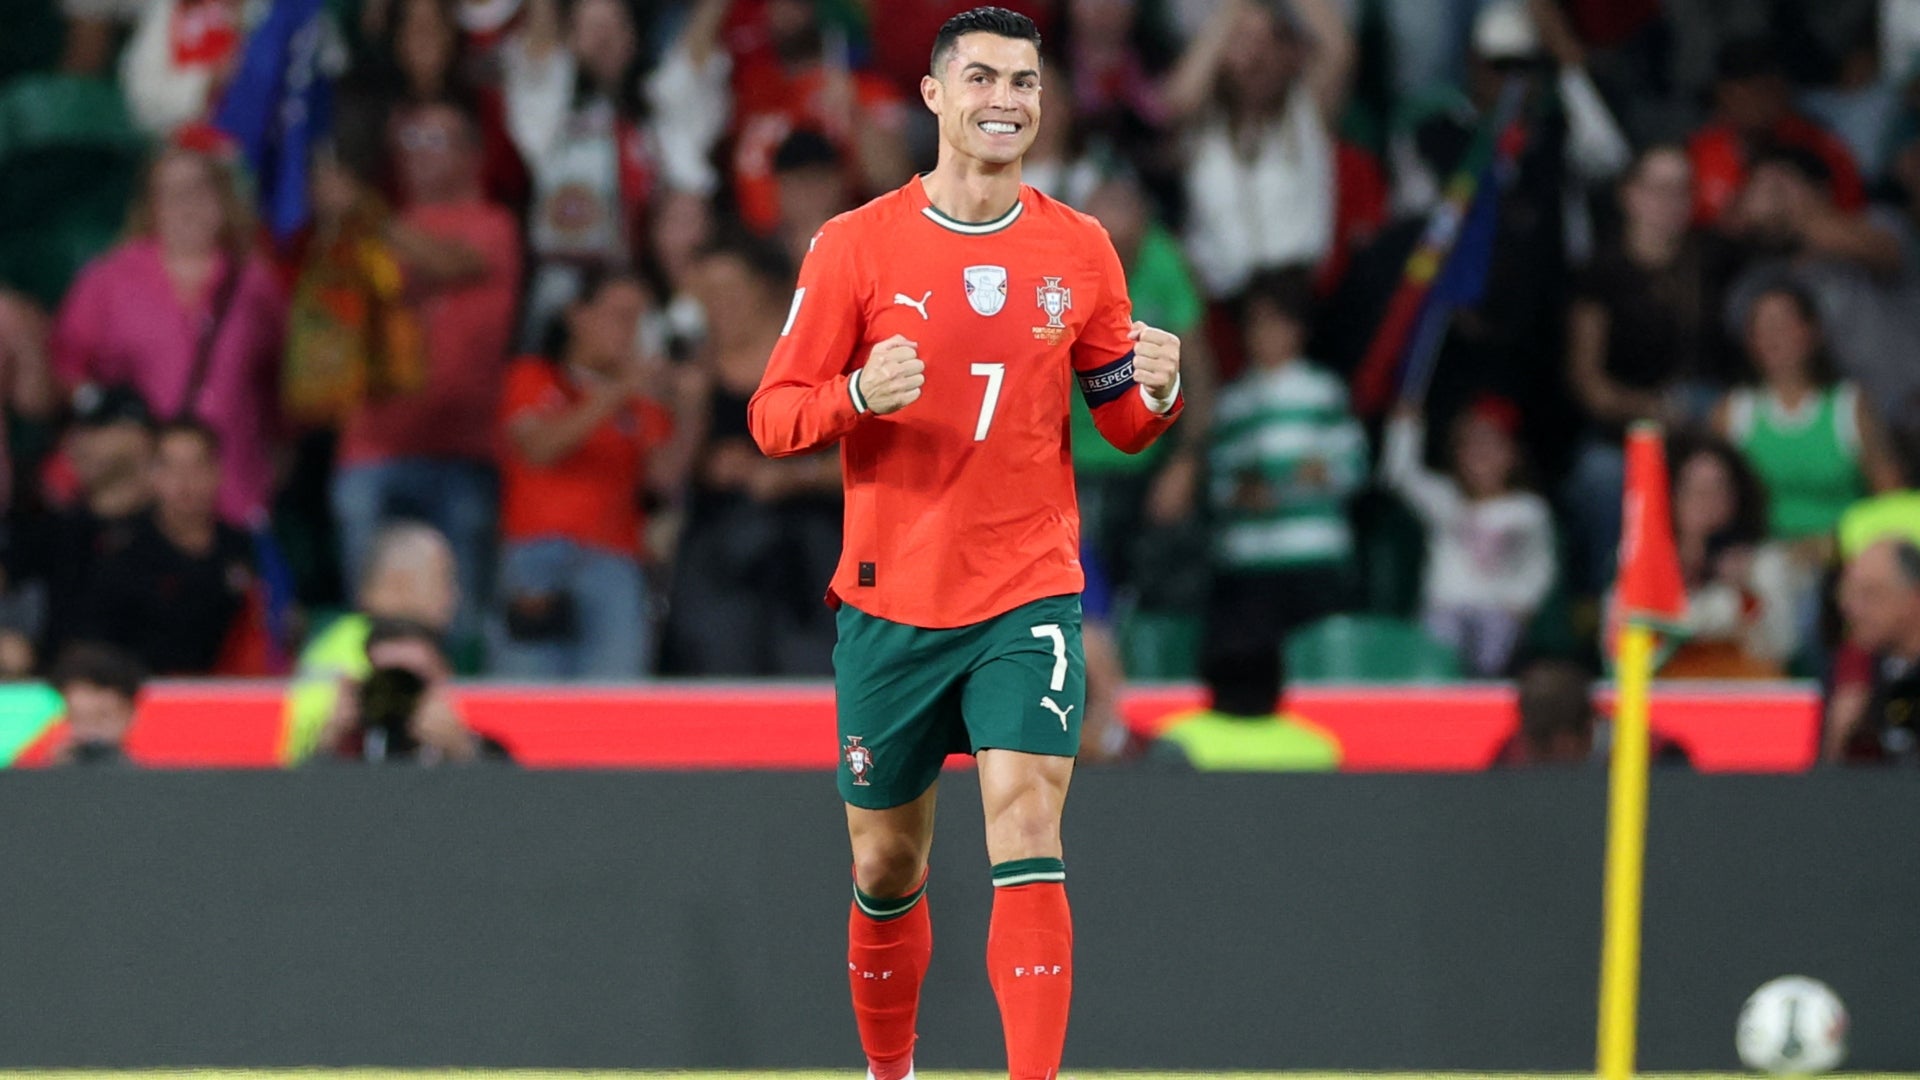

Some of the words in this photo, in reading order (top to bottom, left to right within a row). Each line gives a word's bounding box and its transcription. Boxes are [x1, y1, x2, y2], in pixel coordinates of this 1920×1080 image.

[971, 362, 1005, 441] 7
[1088, 364, 1132, 388] RESPECT
[1030, 624, 1067, 691] 7
